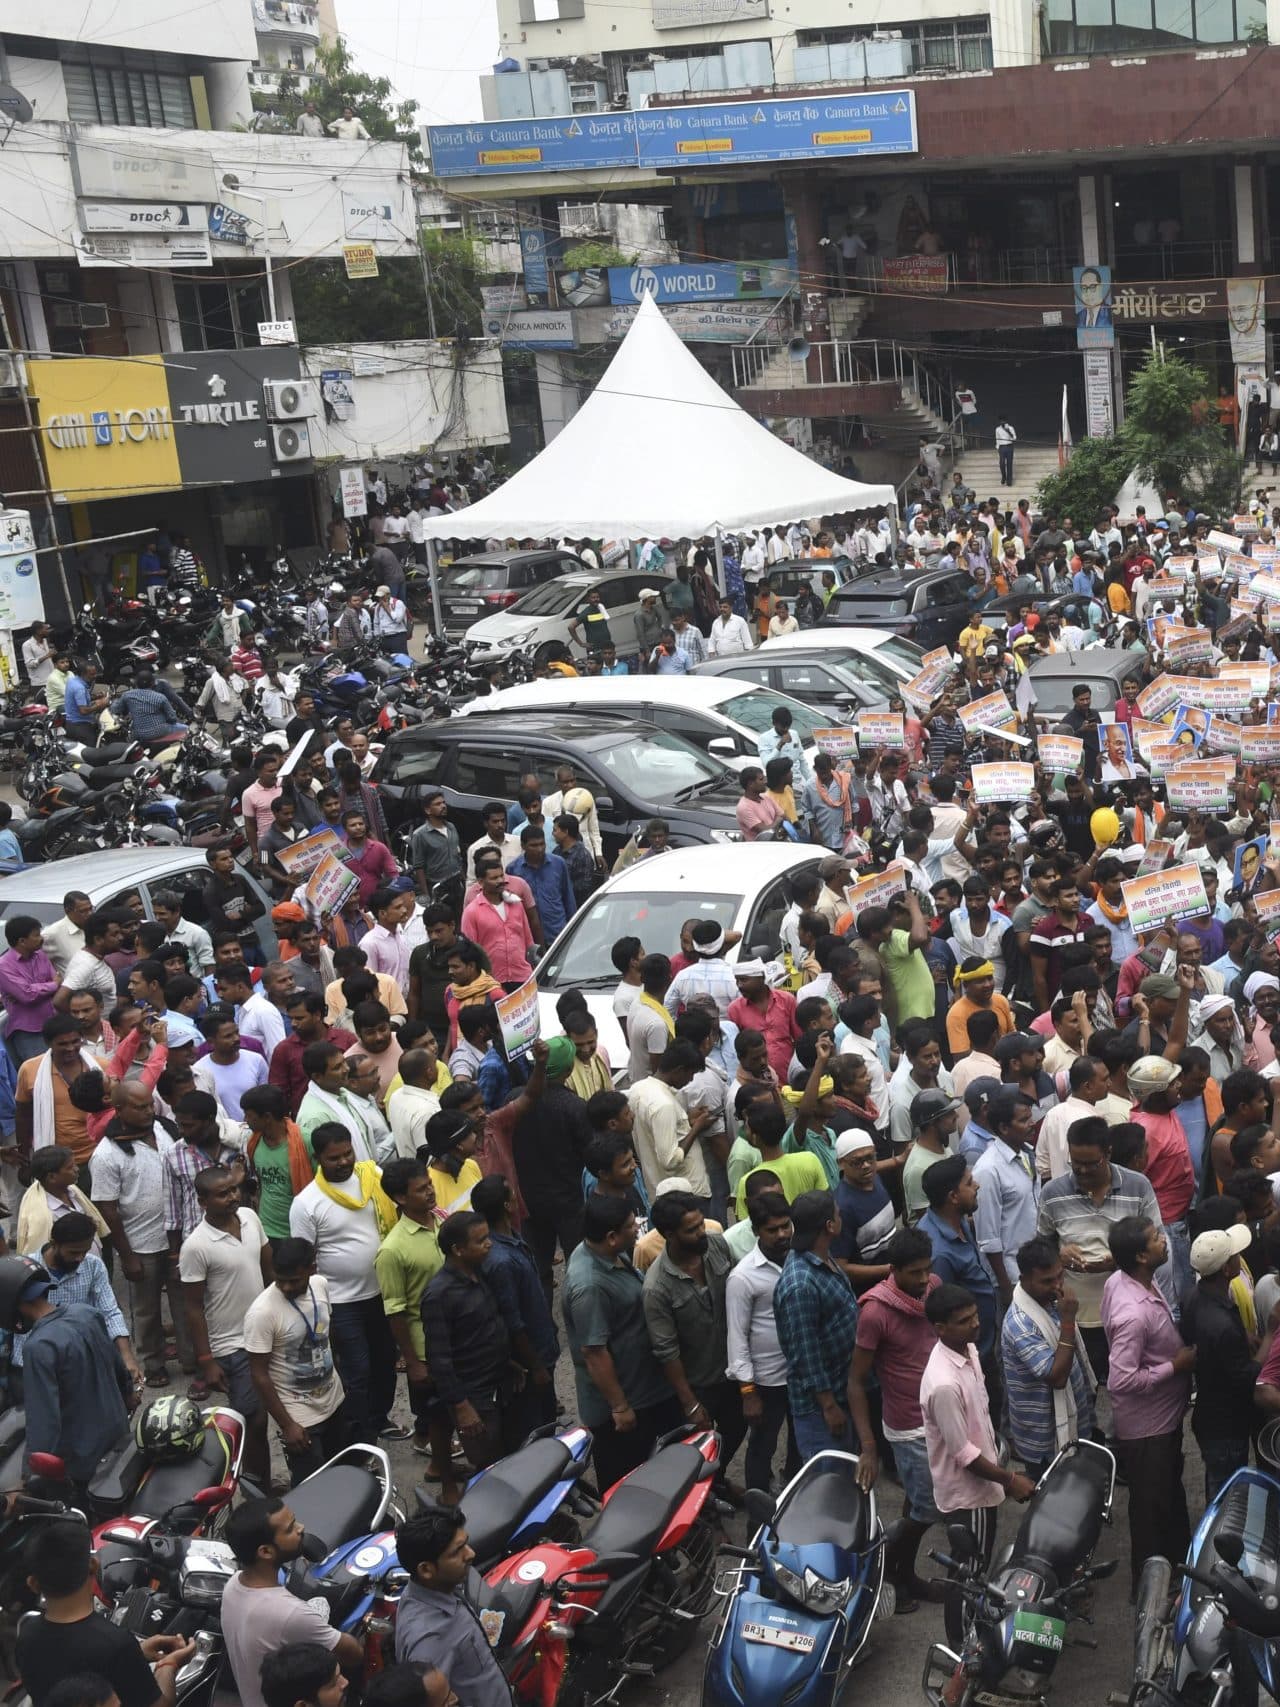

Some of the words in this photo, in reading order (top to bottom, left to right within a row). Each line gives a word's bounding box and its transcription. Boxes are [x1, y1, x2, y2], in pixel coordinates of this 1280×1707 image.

[773, 108, 800, 123] केनरा
[803, 106, 819, 120] बैंक
[825, 106, 860, 119] Canara
[864, 103, 889, 117] Bank
[589, 119, 620, 137] केनरा
[638, 117, 665, 131] केनरा
[667, 114, 682, 129] बैंक
[688, 116, 721, 128] Canara
[724, 112, 749, 126] Bank
[432, 130, 463, 146] केनरा
[466, 127, 483, 144] बैंक
[490, 128, 530, 143] Canara
[533, 125, 561, 140] Bank
[112, 160, 151, 172] DTDC
[130, 213, 162, 222] DTDC
[350, 208, 373, 217] DTDC
[663, 275, 716, 293] WORLD
[1112, 287, 1159, 318] मौर्या
[260, 323, 290, 332] DTDC
[502, 322, 532, 331] KONICA
[533, 322, 567, 330] MINOLTA
[180, 400, 261, 427] TURTLE
[769, 1616, 798, 1626] HONDA
[775, 1630, 781, 1639] T
[794, 1636, 813, 1647] 1206
[1016, 1629, 1035, 1642] पटना
